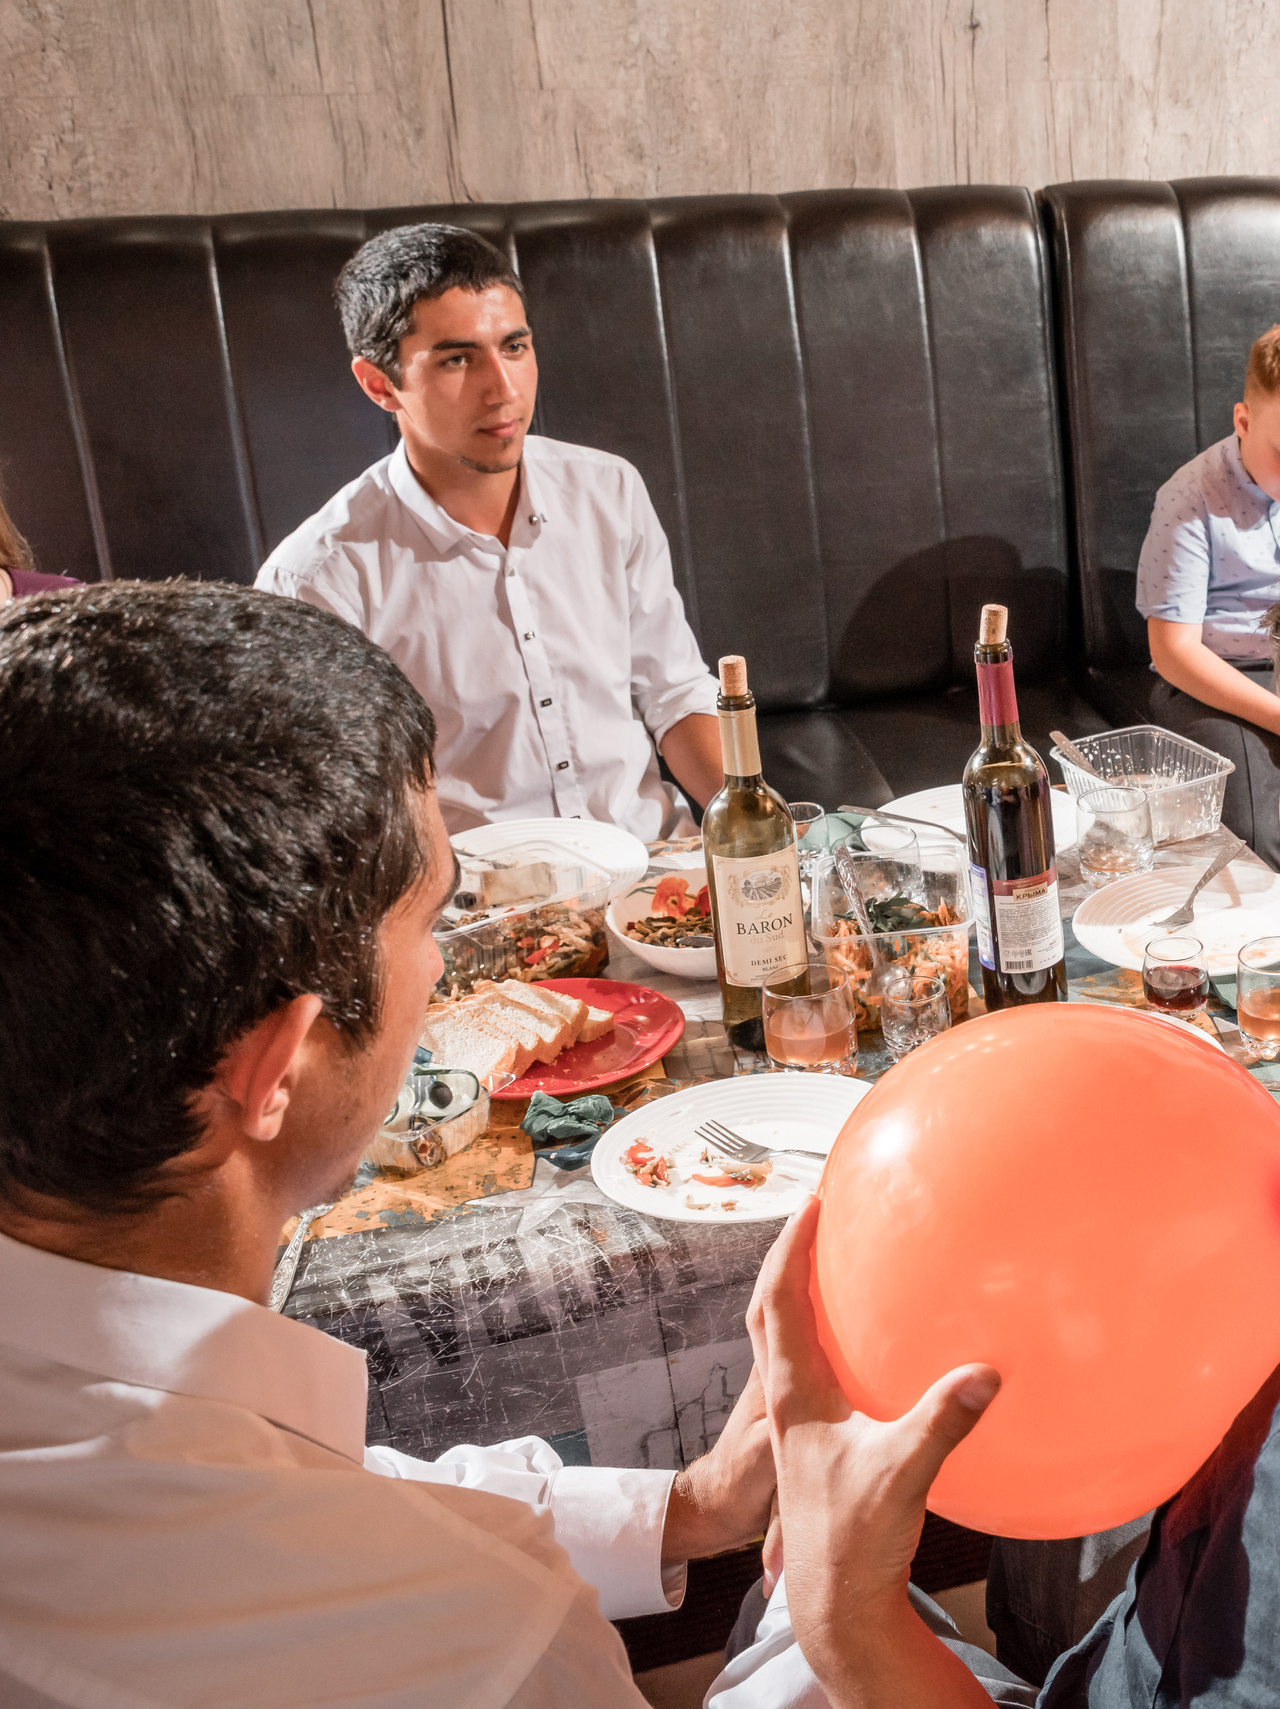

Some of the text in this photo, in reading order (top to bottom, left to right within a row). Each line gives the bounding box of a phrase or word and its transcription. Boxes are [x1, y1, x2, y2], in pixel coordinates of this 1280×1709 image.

[1016, 888, 1046, 900] КРЫМА
[736, 913, 792, 935] BARON
[750, 930, 784, 944] du Sud
[751, 954, 787, 966] DEMI SEC
